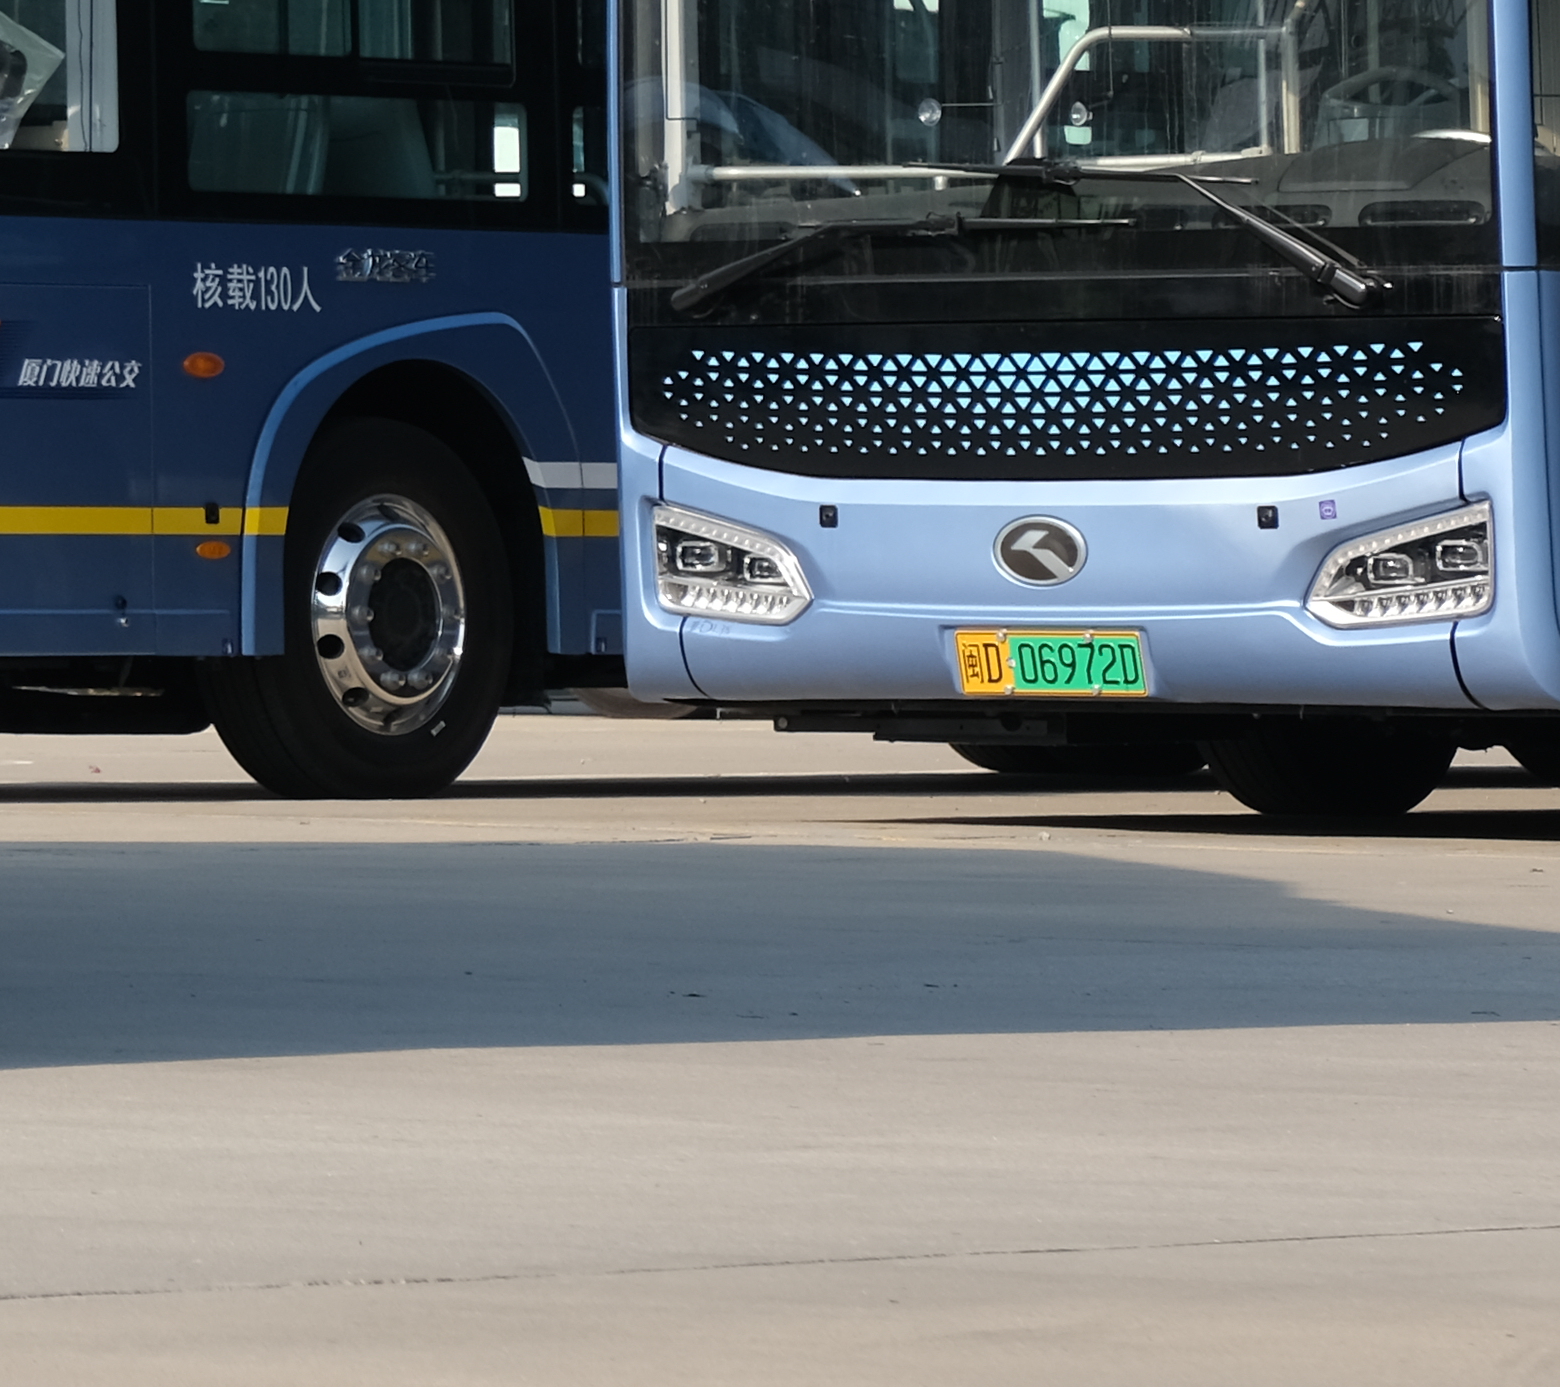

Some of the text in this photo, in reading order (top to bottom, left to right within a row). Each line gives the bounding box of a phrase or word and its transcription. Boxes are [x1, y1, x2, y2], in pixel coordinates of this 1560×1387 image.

[192, 262, 322, 312] 核载130人
[17, 358, 142, 388] 厦门快速公交
